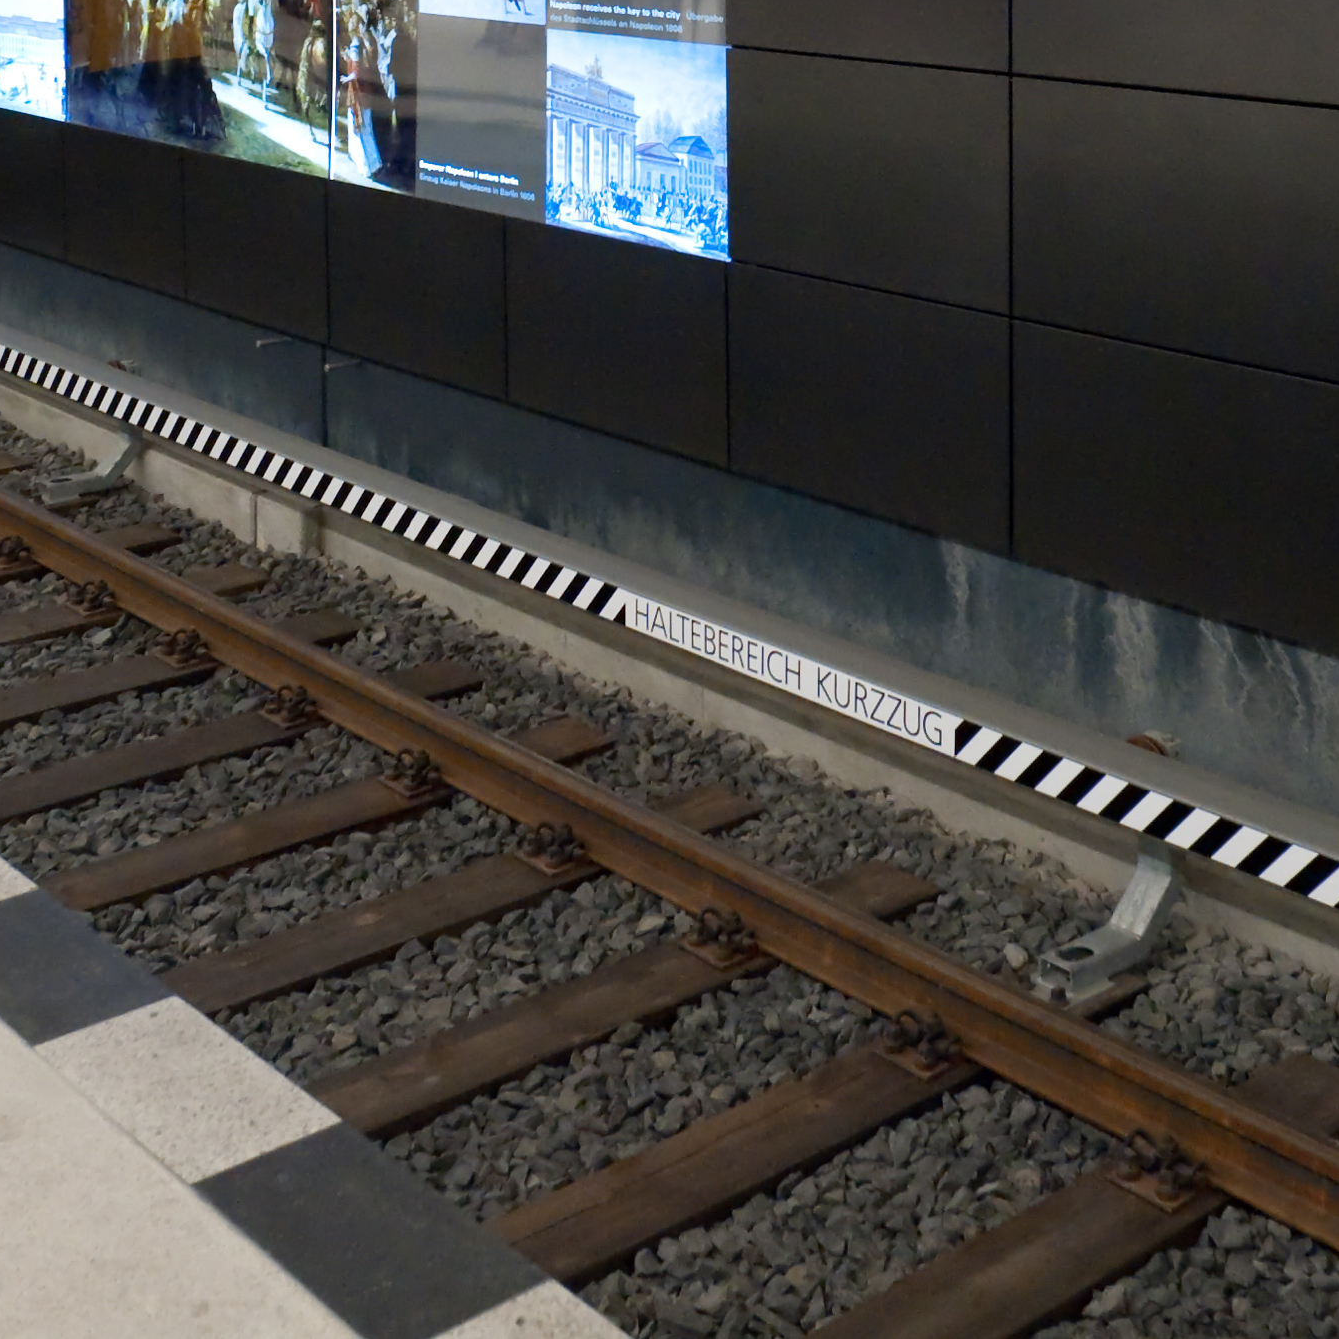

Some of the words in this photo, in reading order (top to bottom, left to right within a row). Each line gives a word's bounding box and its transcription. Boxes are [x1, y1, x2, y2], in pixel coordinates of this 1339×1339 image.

[549, 0, 582, 11] Napoleon
[582, 3, 613, 14] receives
[613, 5, 626, 15] the
[627, 6, 641, 18] key
[642, 8, 651, 17] to
[651, 8, 665, 18] the
[665, 9, 681, 21] city
[634, 598, 801, 691] HALTEBEREICH
[817, 666, 943, 746] KURZZUG
